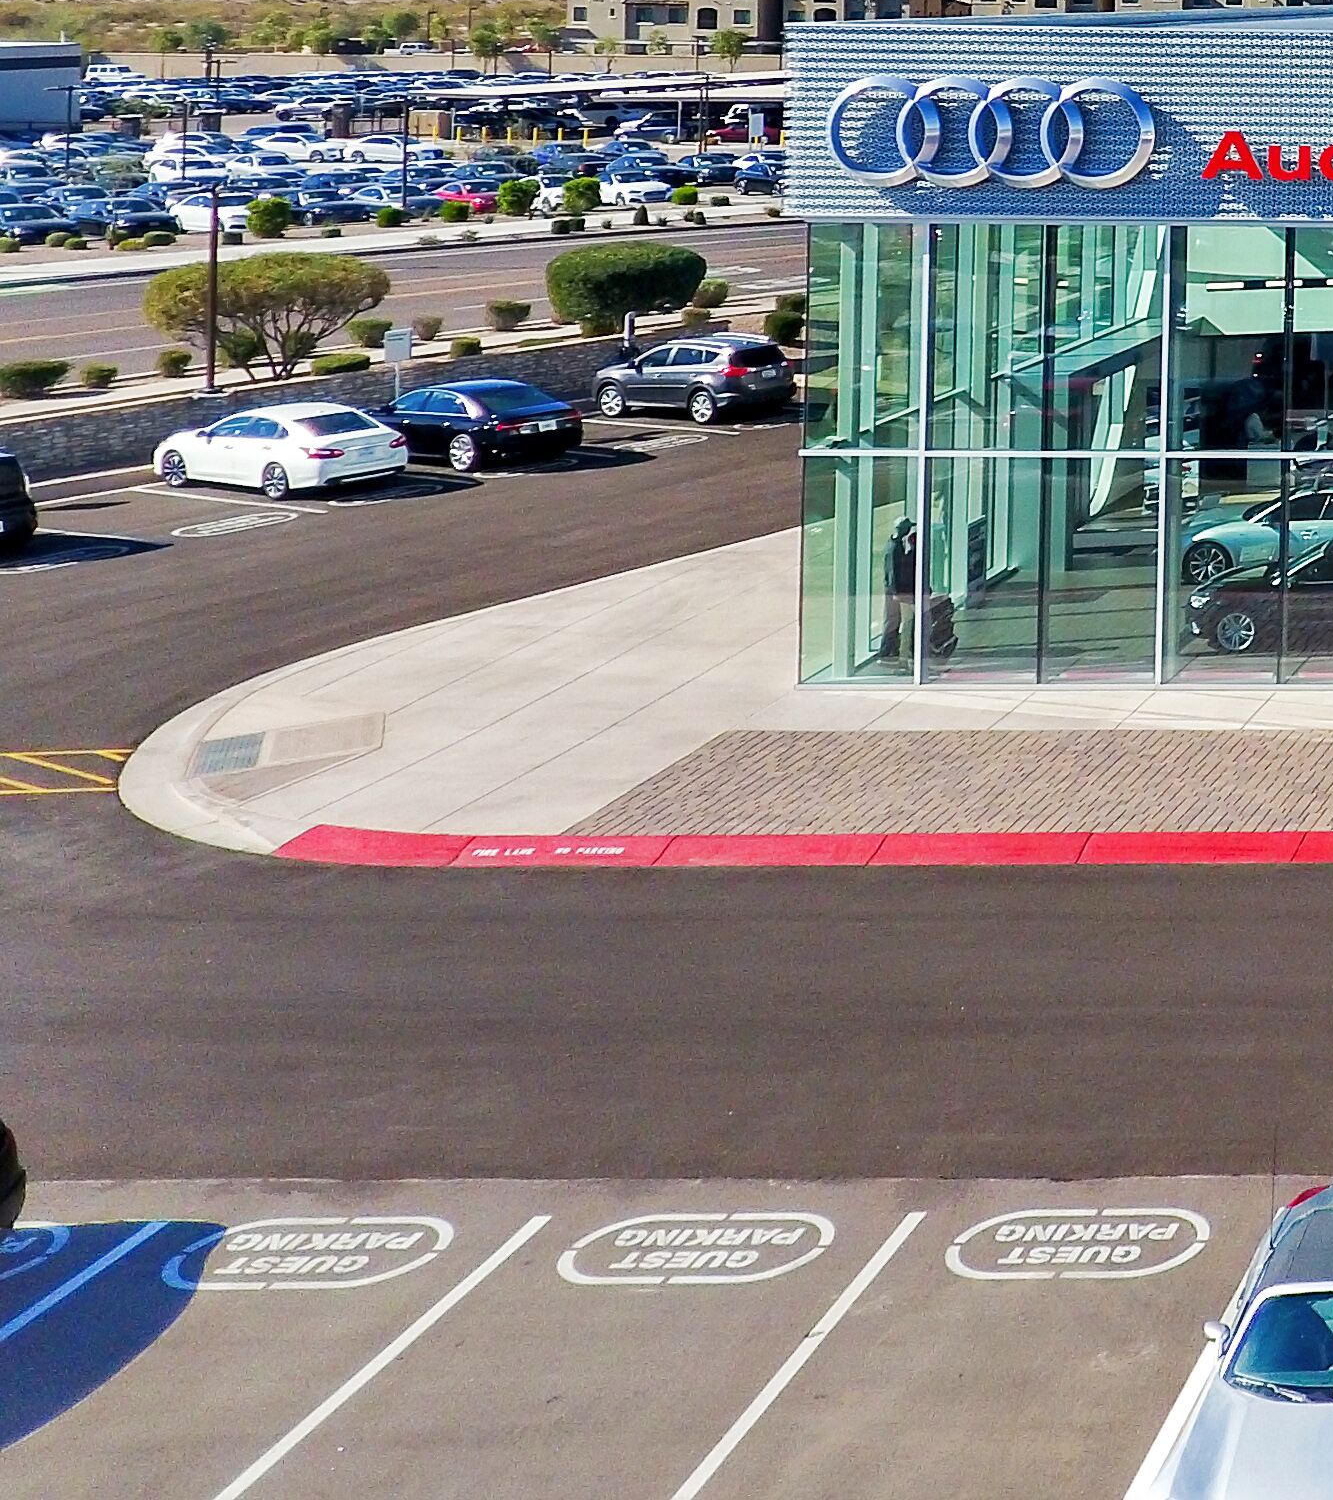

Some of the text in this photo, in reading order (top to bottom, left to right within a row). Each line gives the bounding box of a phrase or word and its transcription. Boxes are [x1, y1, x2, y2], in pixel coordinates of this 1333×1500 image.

[226, 1231, 424, 1251] PARKING
[615, 1227, 806, 1247] PARKING
[995, 1223, 1179, 1242] PARKING
[214, 1255, 369, 1274] GUEST
[608, 1251, 759, 1269] GUEST
[997, 1246, 1141, 1264] GUEST
